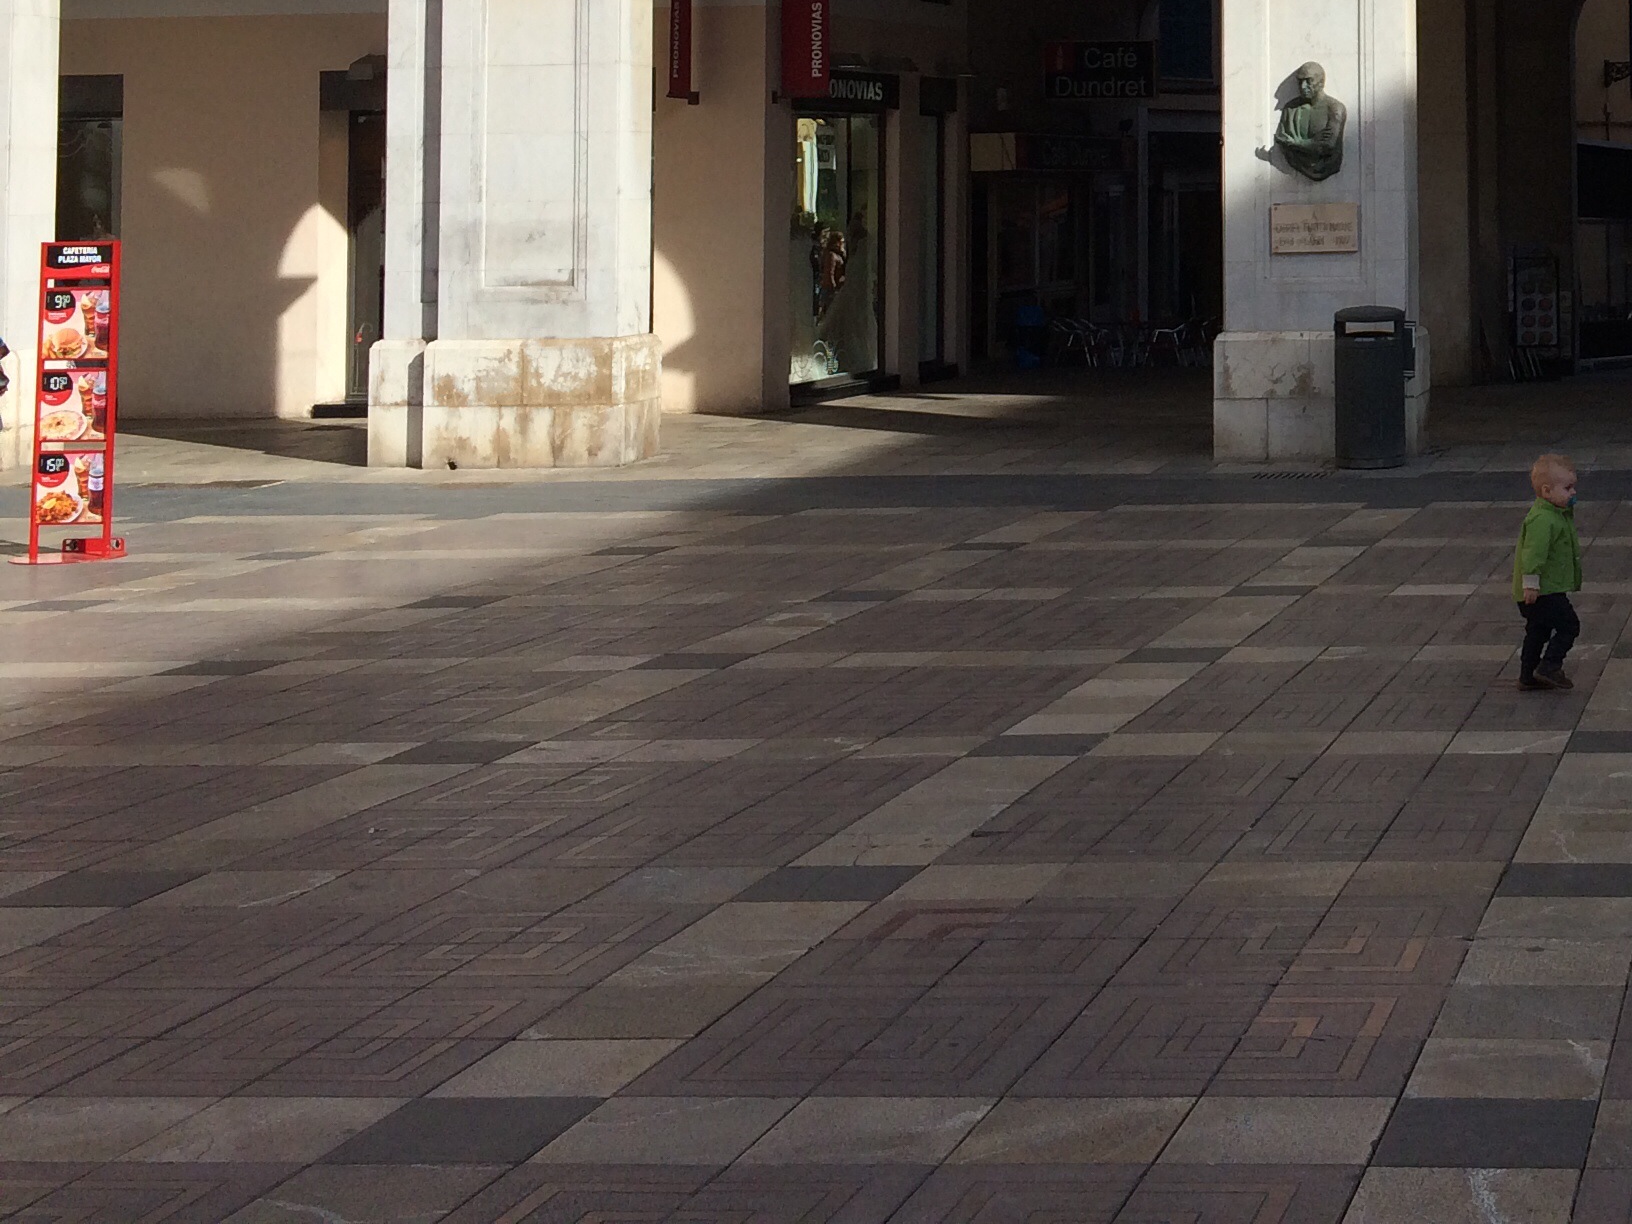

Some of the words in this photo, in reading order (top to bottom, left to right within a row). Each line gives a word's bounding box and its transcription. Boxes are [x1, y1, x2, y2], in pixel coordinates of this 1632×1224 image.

[671, 1, 681, 79] PRONOVIAS
[811, 1, 823, 78] PRONOVIAS
[1084, 46, 1138, 69] Café
[1055, 75, 1147, 97] Dundret
[63, 246, 98, 255] CAFETERIA
[79, 255, 102, 263] MAYOR
